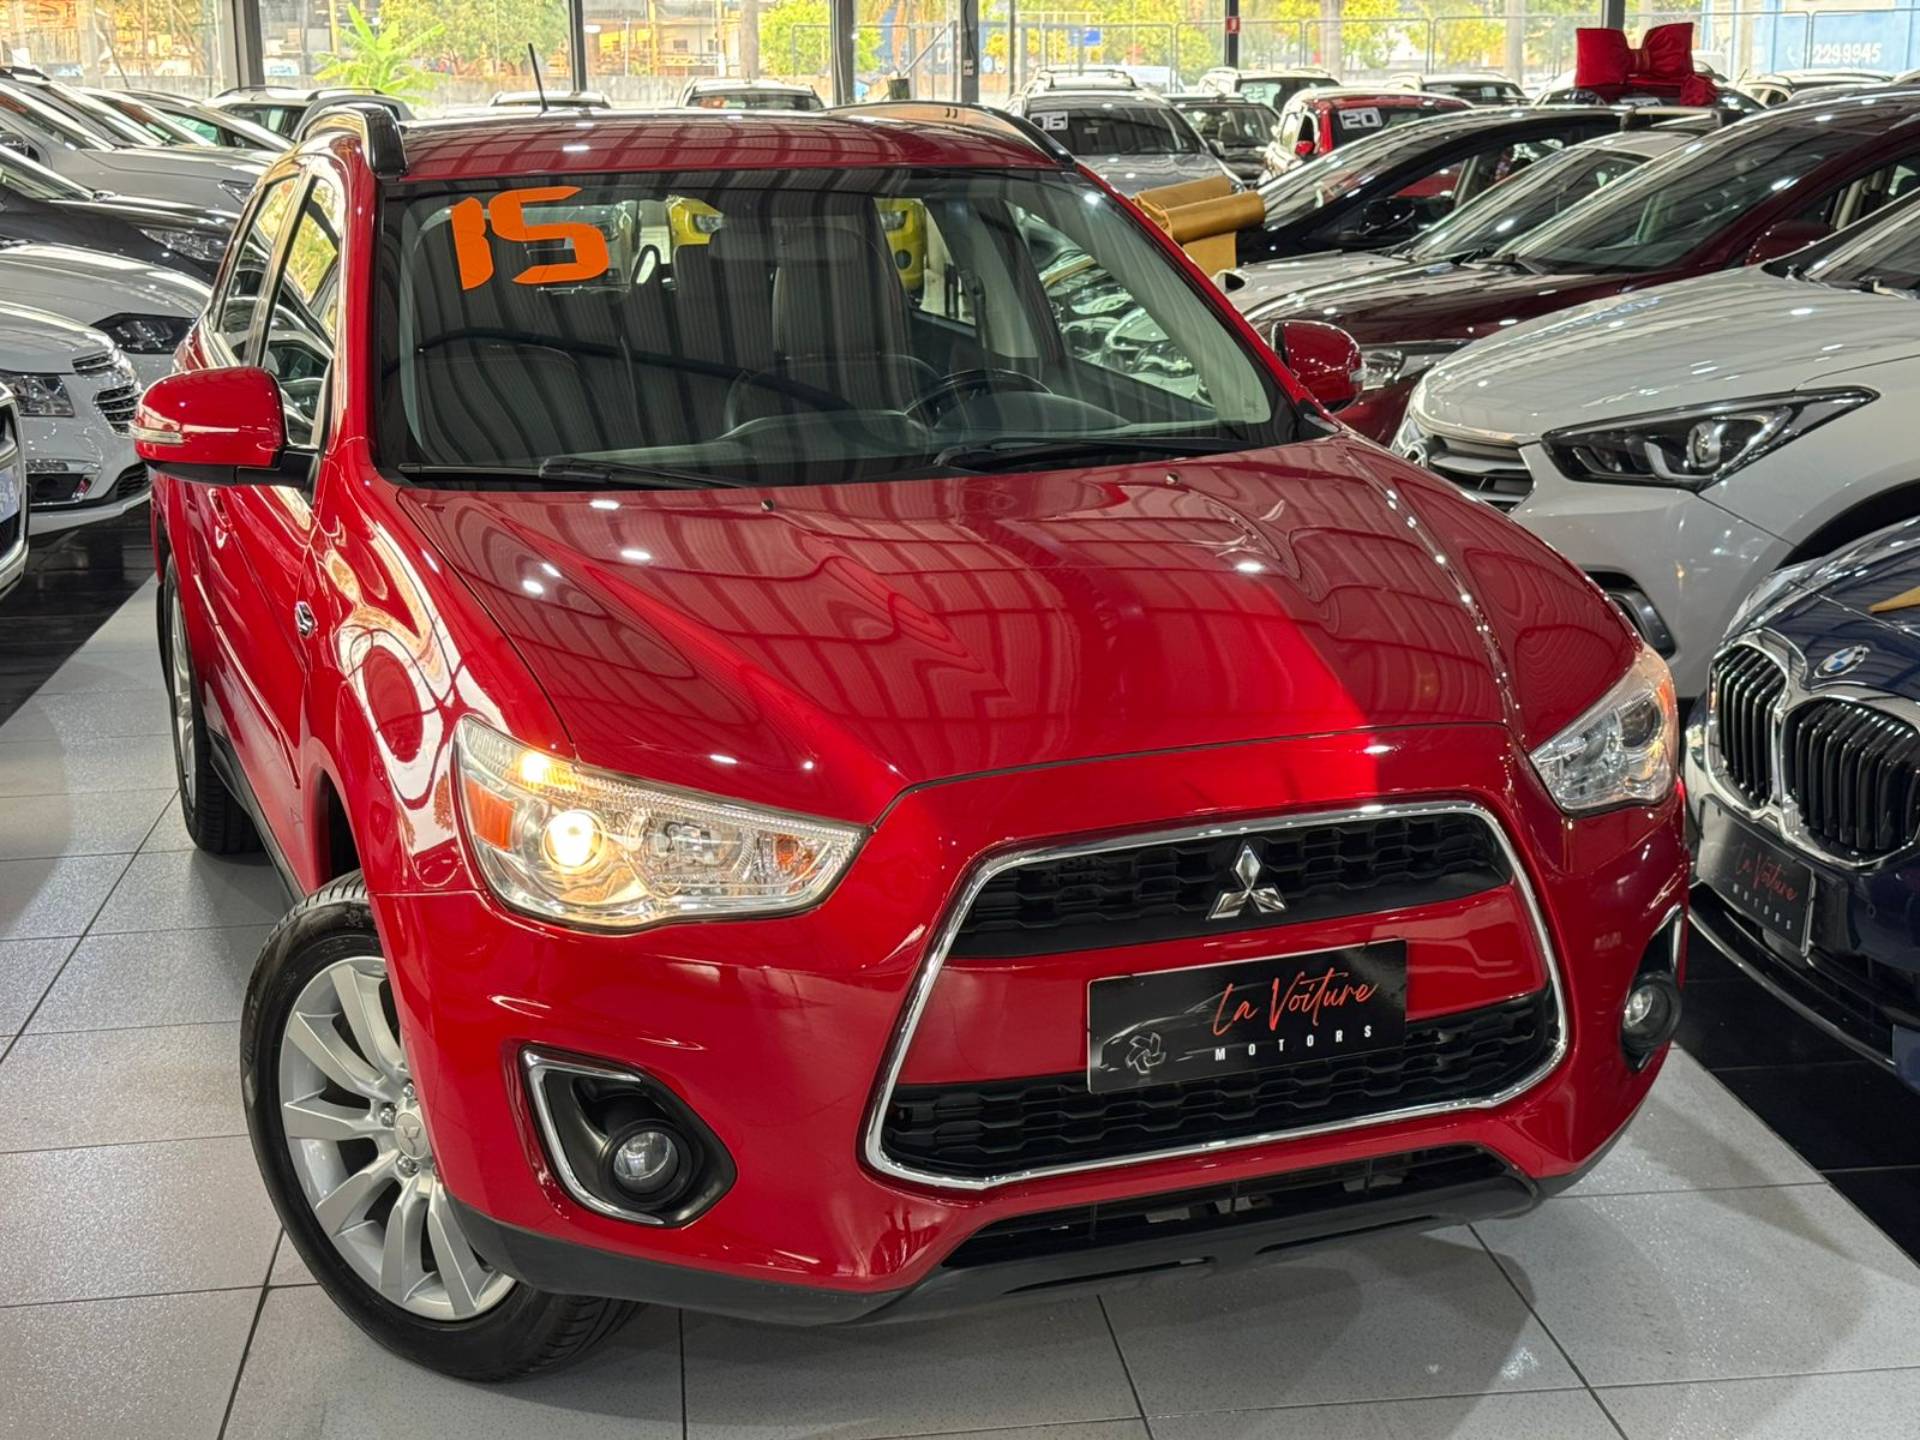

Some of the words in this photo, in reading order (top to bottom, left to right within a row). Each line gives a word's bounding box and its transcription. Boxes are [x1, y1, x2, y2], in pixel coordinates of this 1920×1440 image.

[1341, 109, 1379, 128] 20
[451, 185, 609, 291] 15
[1212, 983, 1261, 1036] La
[1268, 967, 1379, 1032] Voiture
